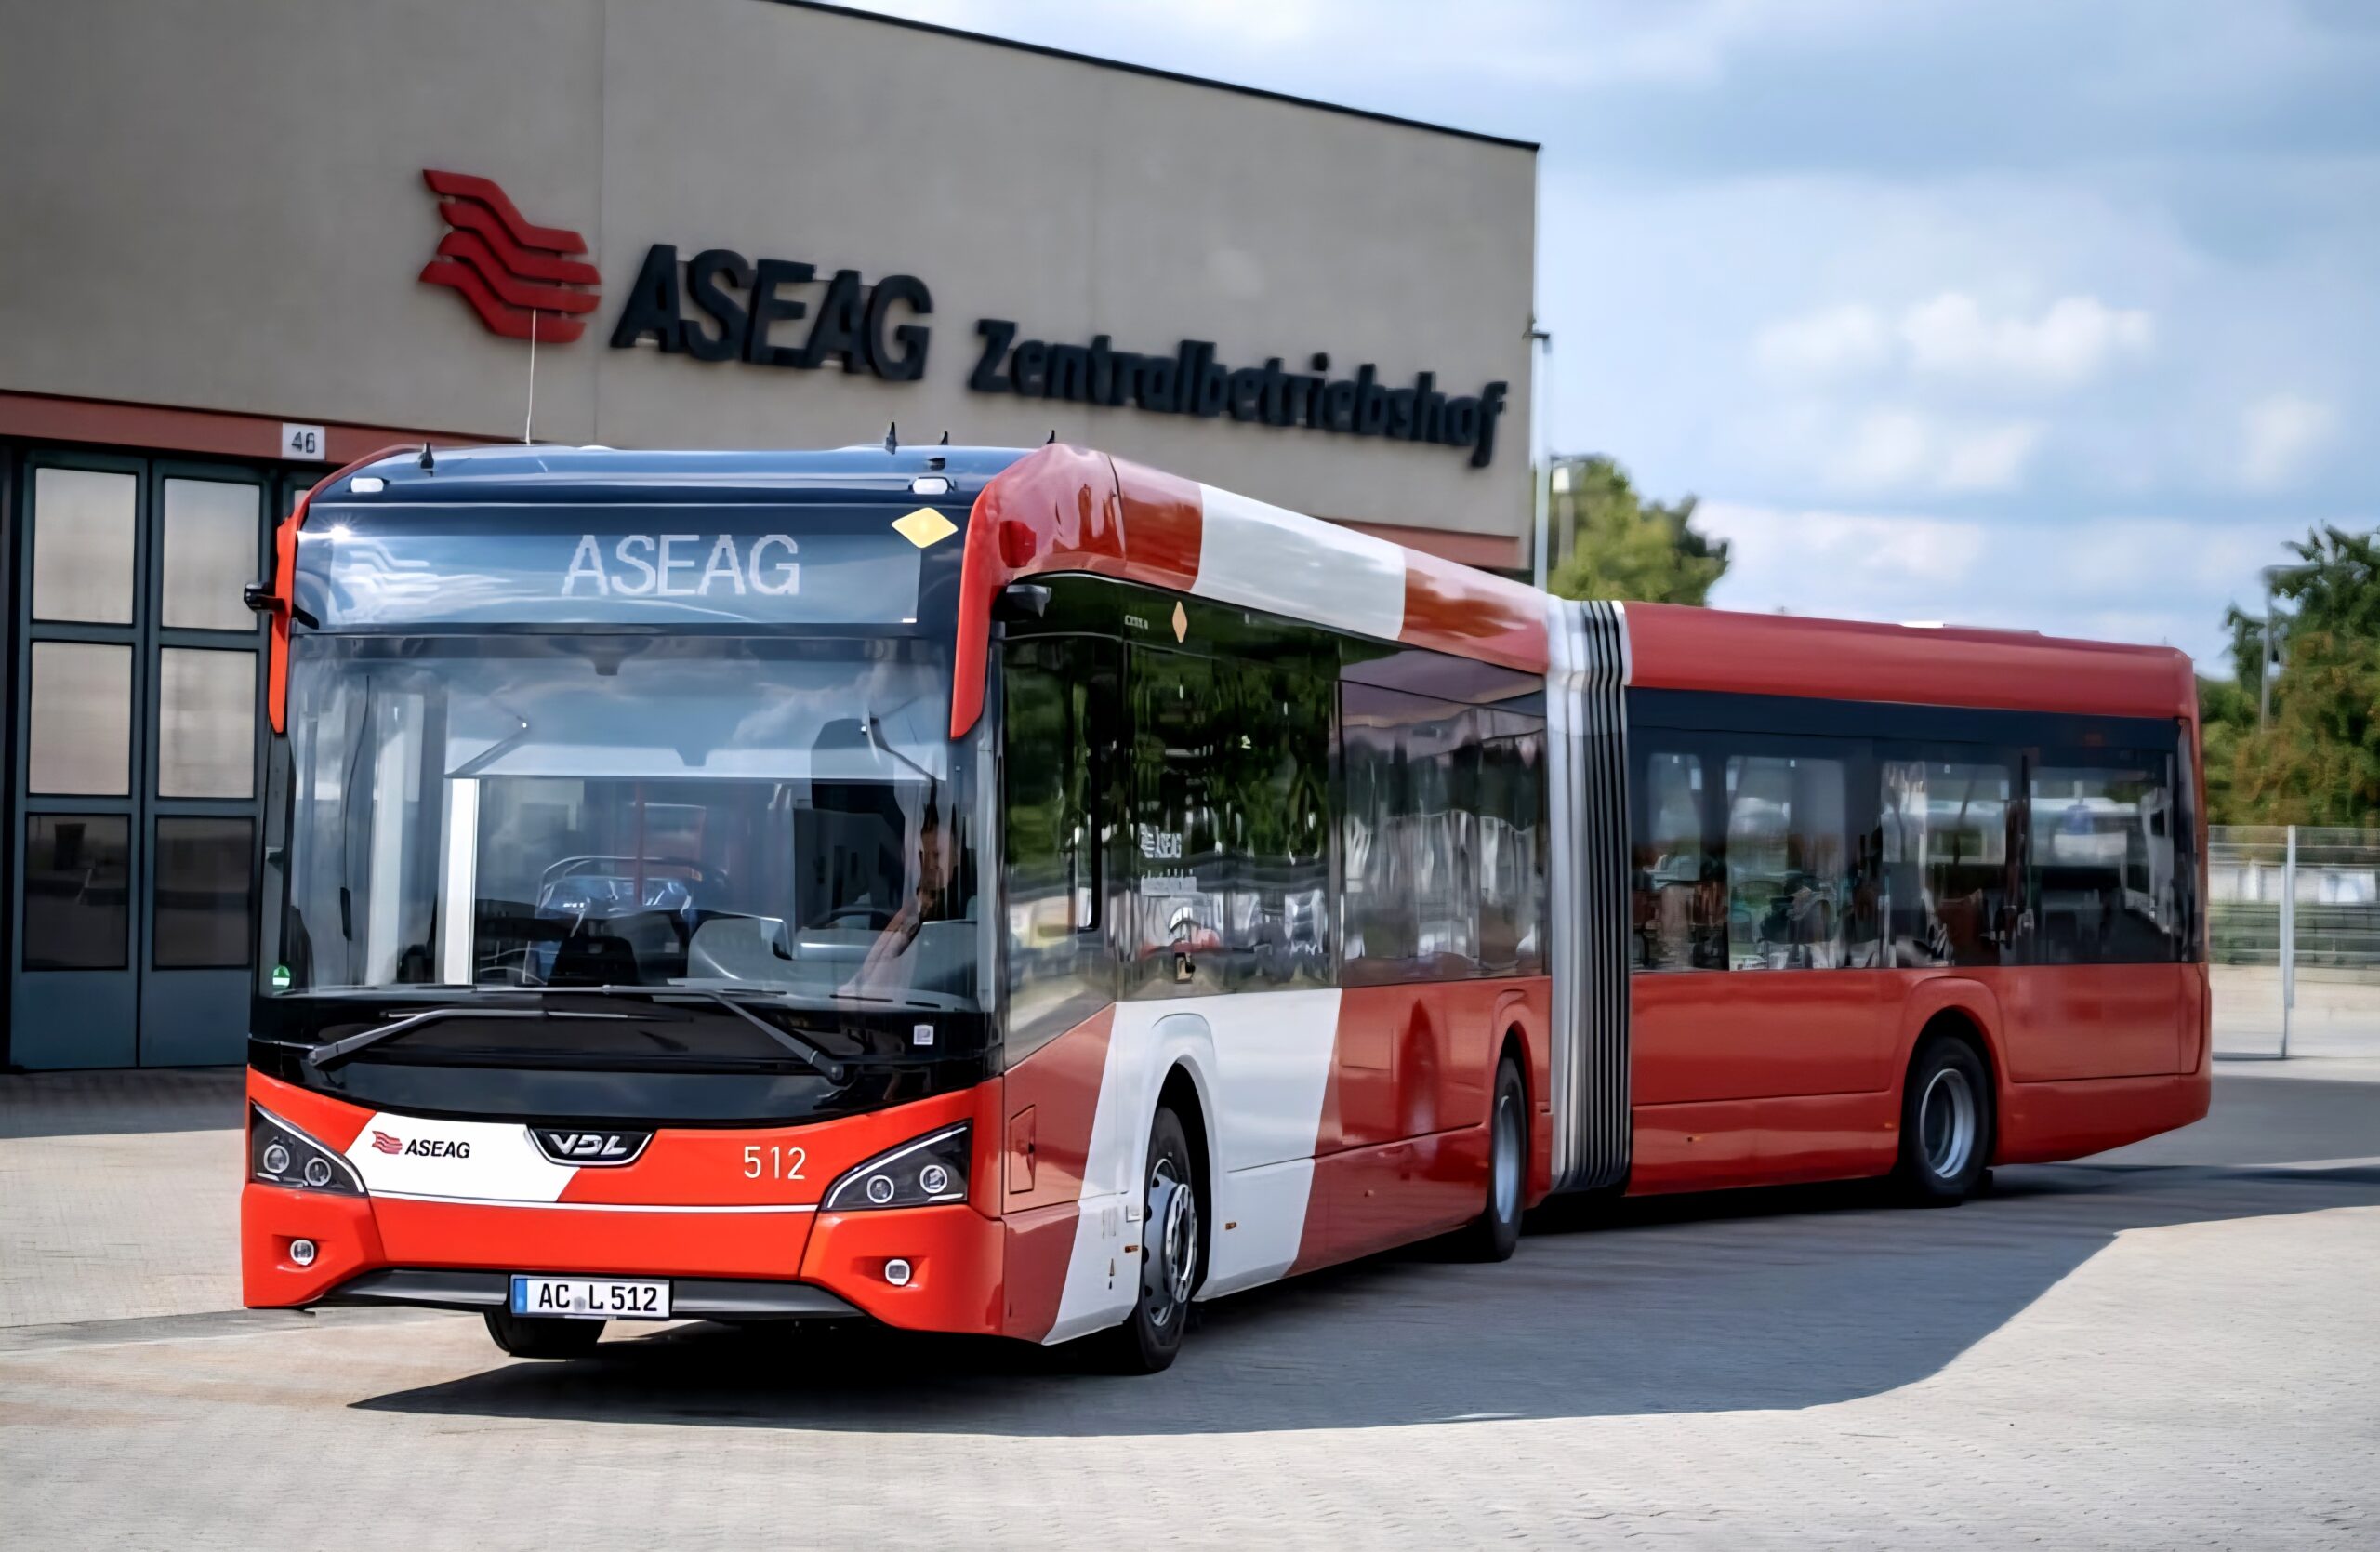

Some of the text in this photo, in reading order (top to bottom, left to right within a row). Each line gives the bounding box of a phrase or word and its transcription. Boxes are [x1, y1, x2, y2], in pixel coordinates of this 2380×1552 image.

[610, 244, 1508, 468] ASEAG Zentralbetriebshof
[562, 534, 800, 595] ASEAG
[405, 1139, 470, 1158] ASEAG
[550, 1134, 627, 1155] VDL
[744, 1146, 806, 1179] 512
[539, 1283, 570, 1308] AC
[611, 1286, 657, 1311] 512
